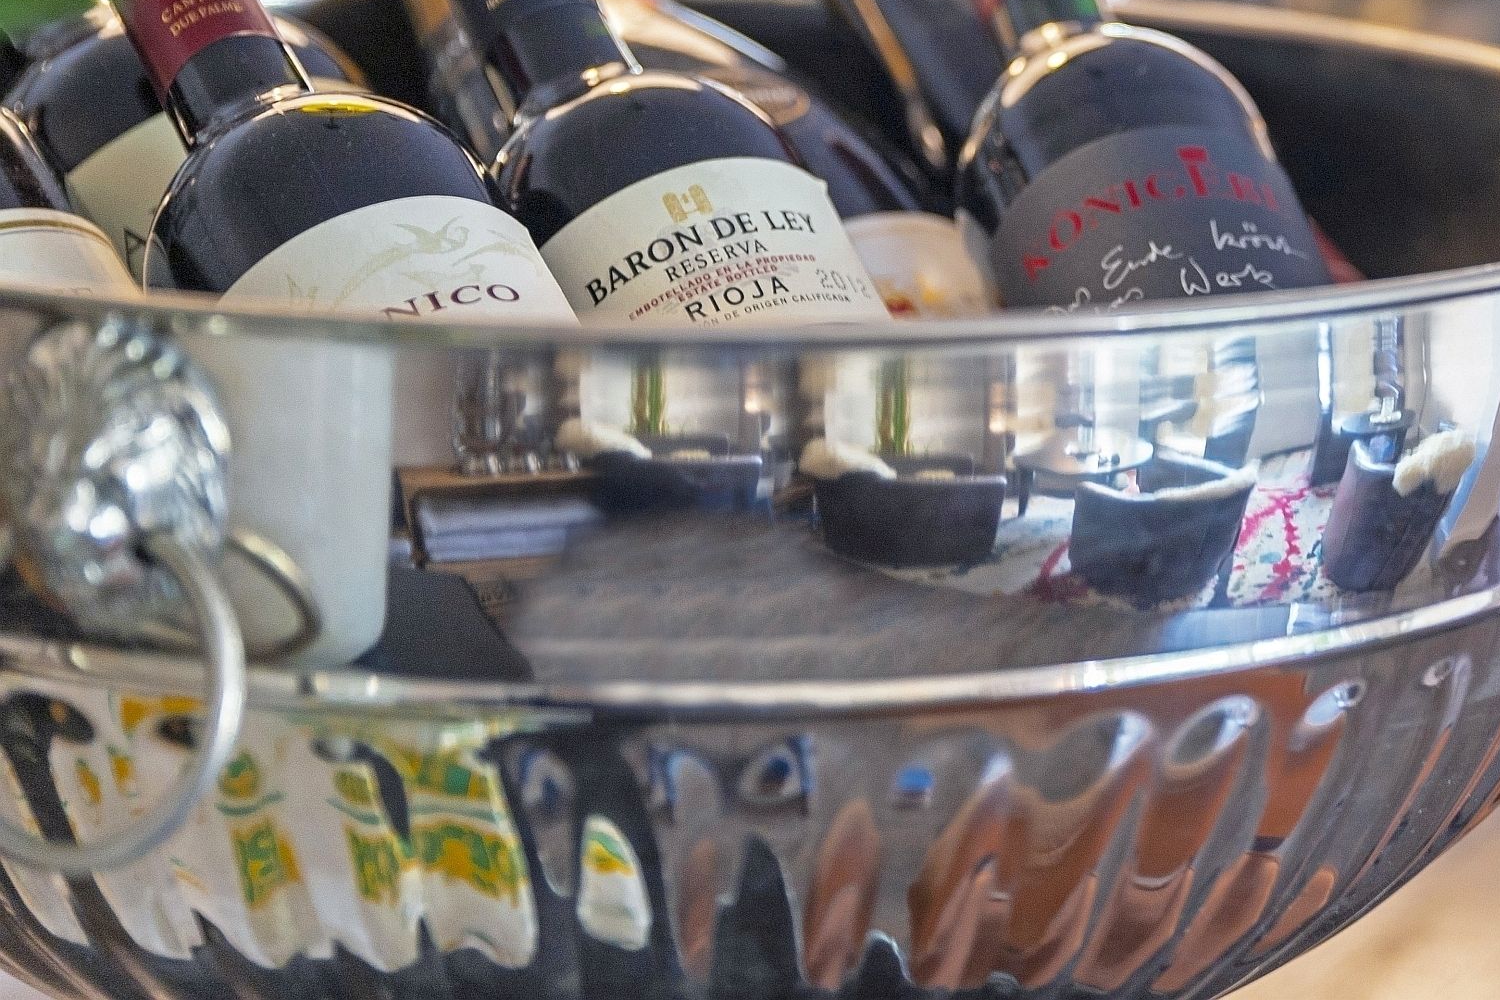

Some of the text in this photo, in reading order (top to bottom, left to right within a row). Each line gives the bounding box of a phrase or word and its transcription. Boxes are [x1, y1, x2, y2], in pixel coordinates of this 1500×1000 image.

[585, 210, 816, 308] BARON DE LEY
[663, 239, 768, 282] RESERVA
[628, 253, 816, 321] EMBOTELLADO EN LA PROPIEDAD
[677, 264, 778, 303] ESTATE BOTTLED
[685, 275, 789, 322] RIOJA
[724, 310, 740, 321] DE
[744, 297, 788, 314] ORIGEN
